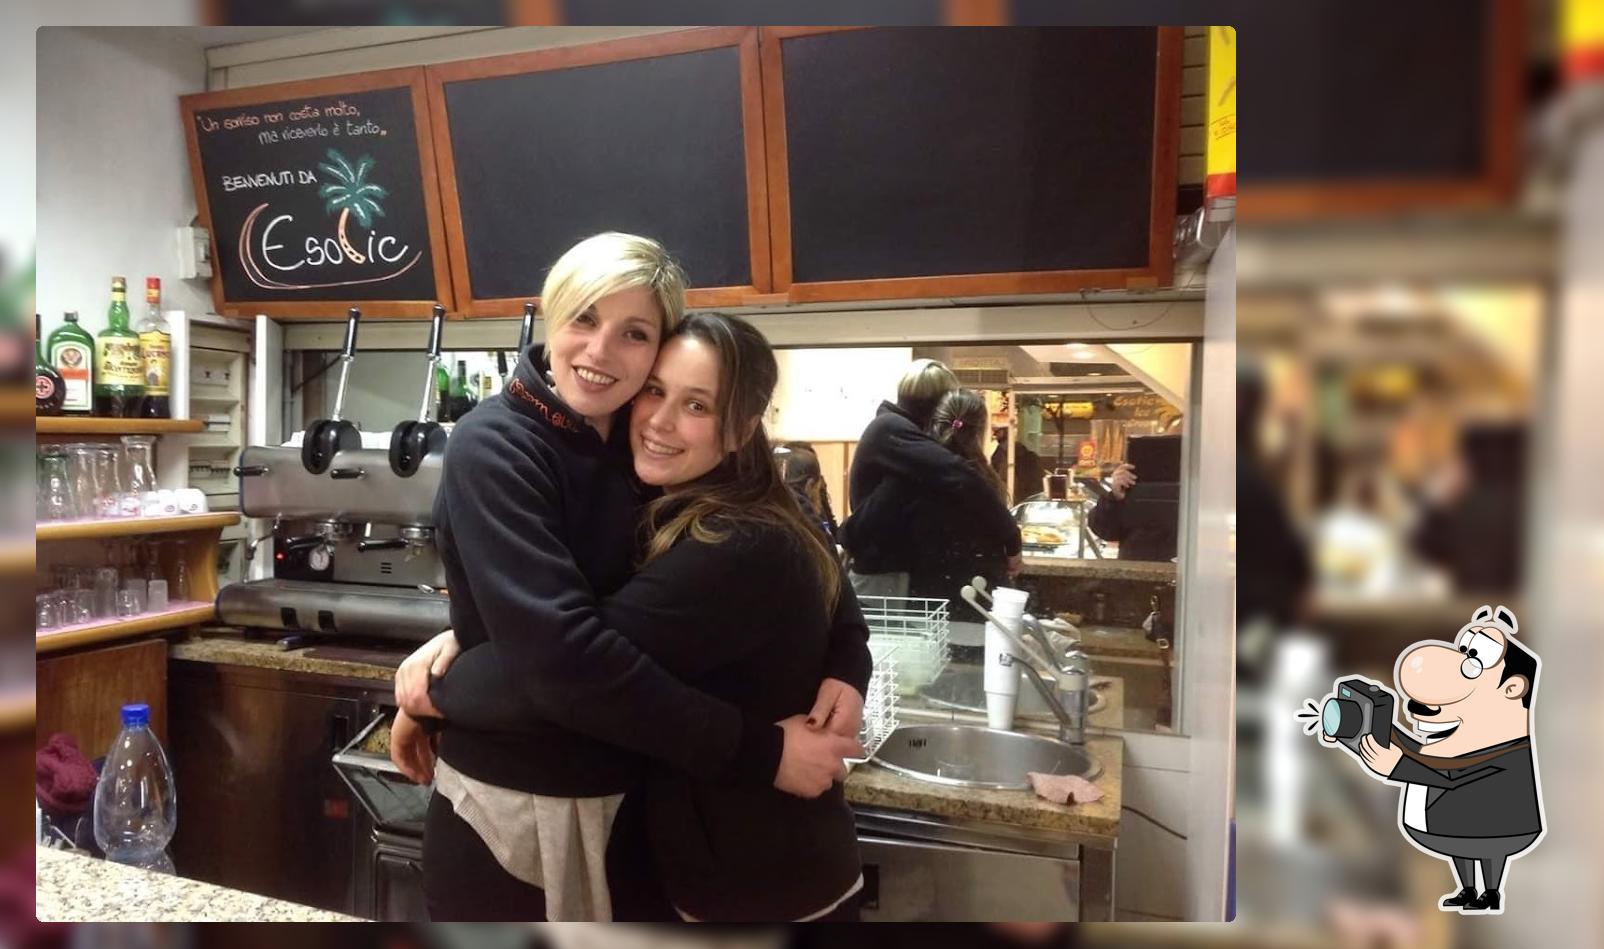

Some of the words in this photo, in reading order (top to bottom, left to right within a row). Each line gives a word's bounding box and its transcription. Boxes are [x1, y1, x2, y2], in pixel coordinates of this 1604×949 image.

[263, 112, 284, 124] non
[289, 105, 320, 122] costa
[222, 170, 295, 192] BENVENUTI
[298, 169, 318, 185] DA
